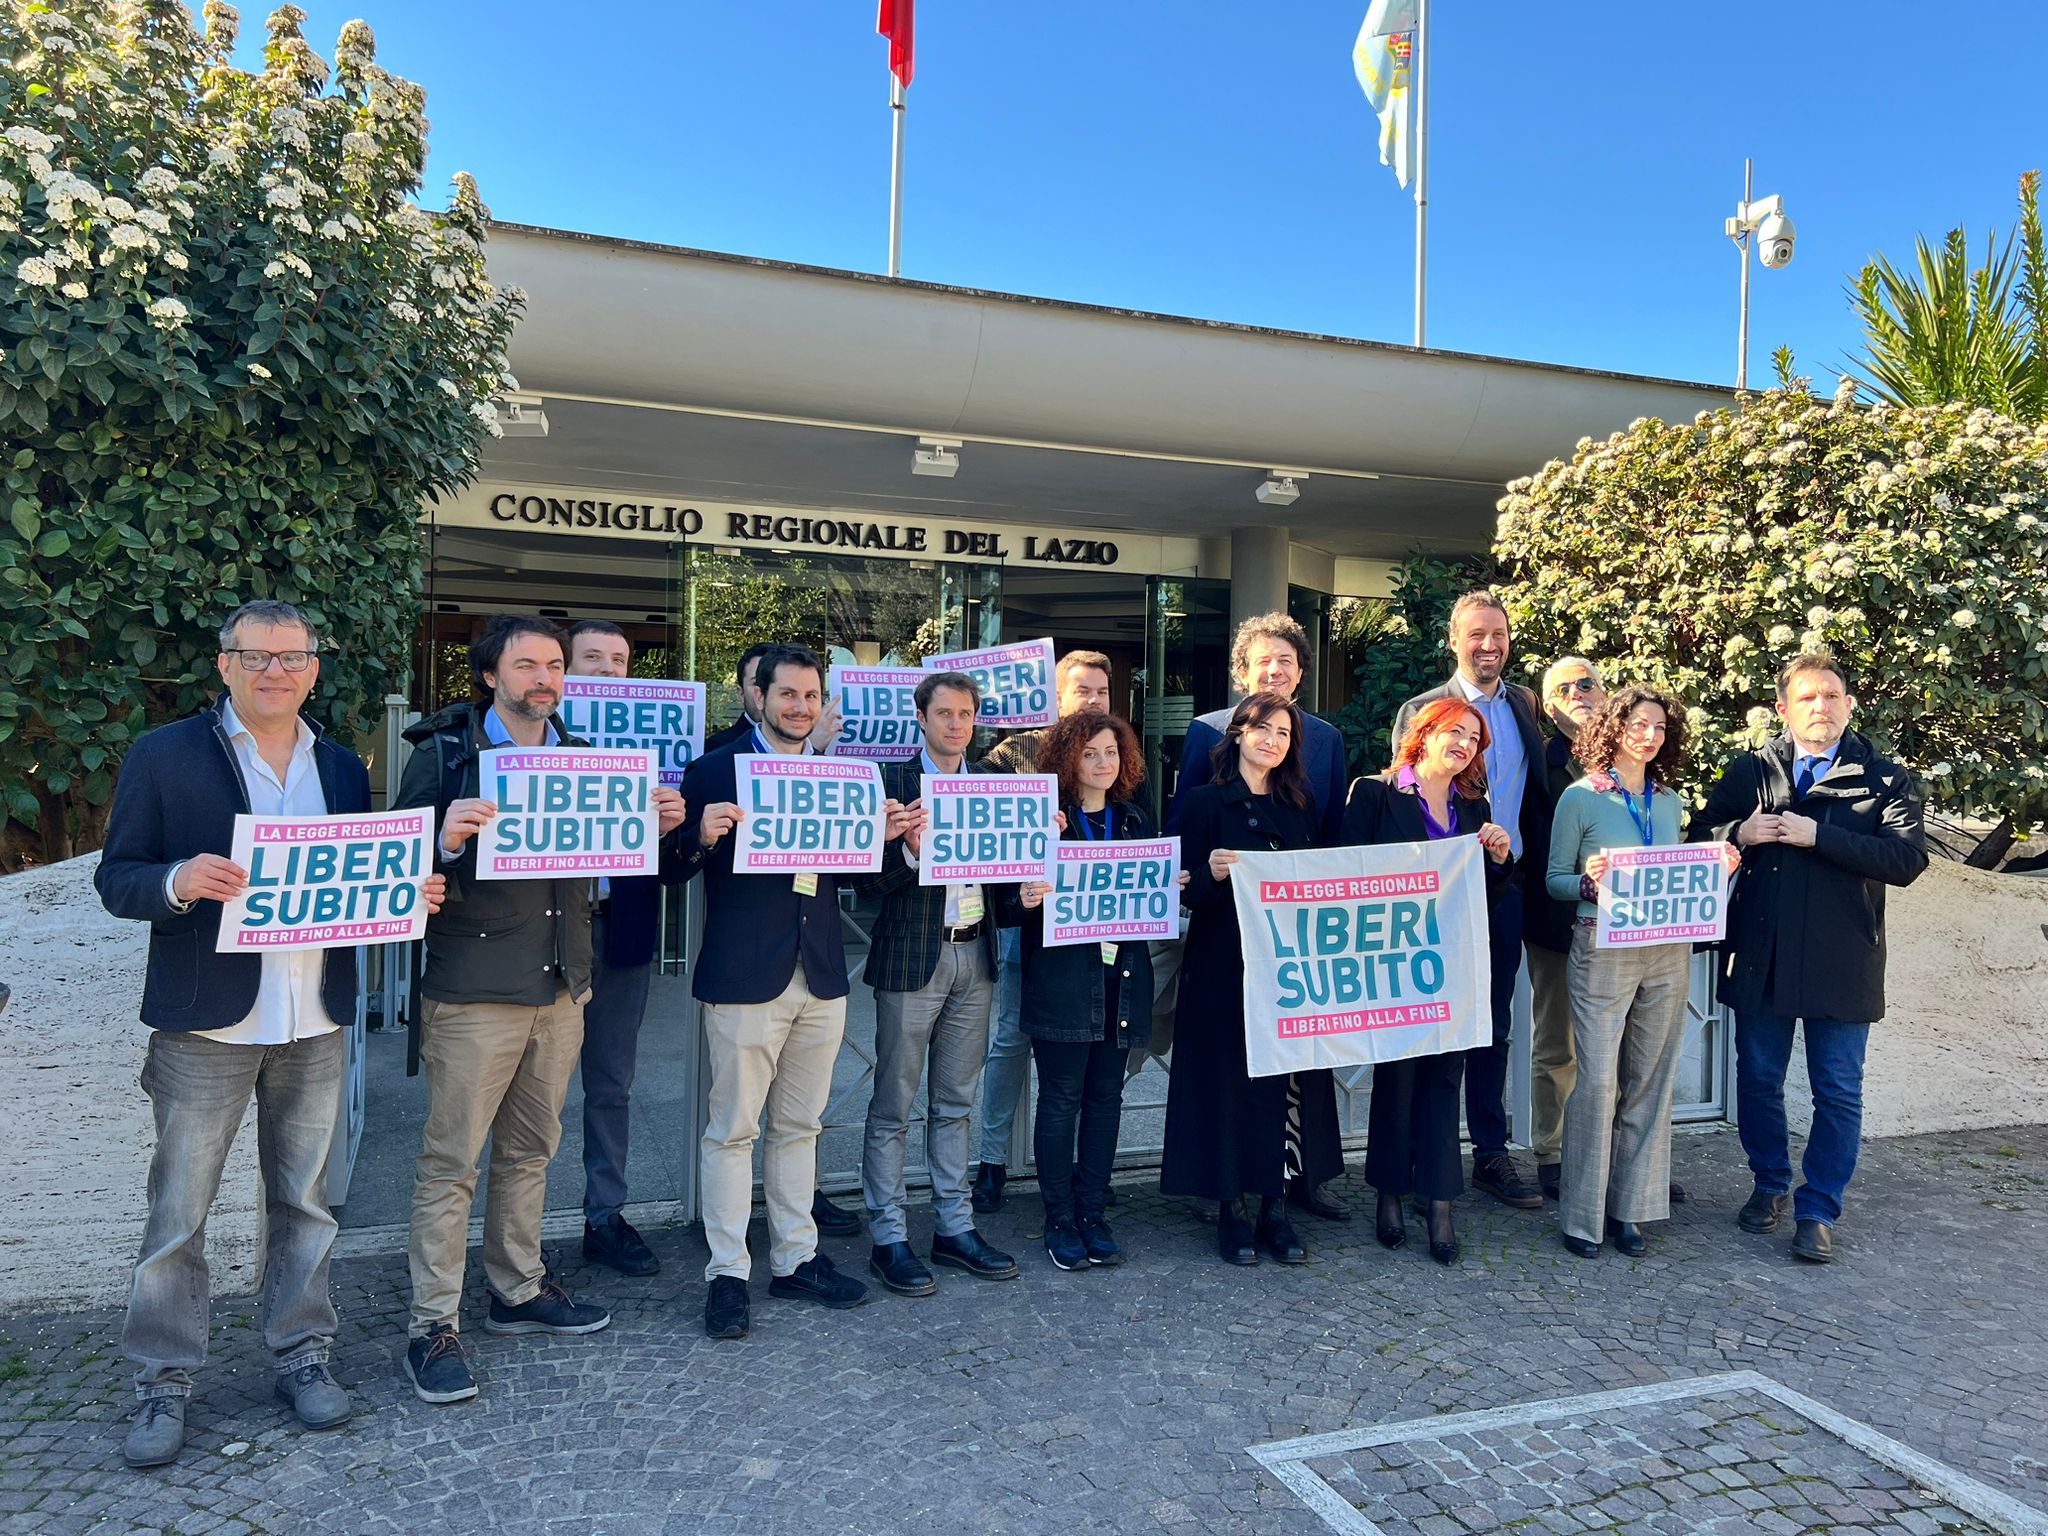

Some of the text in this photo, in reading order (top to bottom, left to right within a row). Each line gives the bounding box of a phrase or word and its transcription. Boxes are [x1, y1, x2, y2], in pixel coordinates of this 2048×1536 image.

[490, 494, 1119, 565] CONSIGLIO REGIONALE DEL LAZIO
[952, 657, 985, 669] LEGGE
[987, 648, 1042, 664] REGIONALE
[844, 673, 926, 684] LA LEGGE REGION
[969, 659, 1046, 695] BERI
[567, 685, 693, 699] LA LEGGE REGIONALE
[841, 687, 914, 717] LIBE
[981, 688, 1047, 716] BITO
[563, 700, 695, 736] LIBERI
[1024, 714, 1046, 723] FINE
[838, 719, 921, 745] SUBIT
[500, 756, 645, 770] LA LEGGE REGIONALE
[837, 747, 916, 756] LIBERI FINO ALLA
[667, 772, 684, 782] FIN
[754, 763, 872, 778] LA LEGGE REGIONALE
[496, 775, 648, 813] LIBERI
[751, 779, 877, 816] LIBERI
[935, 782, 1046, 792] LA LEGGE REGIONALE
[933, 797, 1049, 830] LIBERI
[259, 819, 420, 840] LA LEGGE REGIONALE
[494, 817, 645, 853] SUBITO
[749, 817, 874, 850] SUBITO
[751, 854, 870, 865] LIBERI FINO ALLA FINE
[932, 831, 1049, 863] SUBITO
[1061, 845, 1170, 859] LA LEGGE REGIONALE
[1616, 849, 1720, 865] LA LEGGE REGIONALE
[248, 838, 421, 887] LIBERI
[497, 855, 641, 870] LIBERI FINO ALLA FINE
[934, 867, 968, 877] LIBERI
[970, 866, 994, 876] FINO
[996, 865, 1022, 875] ALLA
[1055, 859, 1171, 893] LIBERI
[1265, 875, 1435, 899] LA LEGGE REGIONALE
[1611, 863, 1720, 898] LIBERI
[241, 882, 417, 927] SUBITO
[1054, 891, 1167, 924] SUBITO
[1609, 895, 1717, 928] SUBITO
[242, 921, 409, 944] LIBERI FINO ALLA FINE
[1057, 923, 1166, 938] LIBERI FINO ALLA FINE
[1264, 898, 1441, 958] LIBERI
[1611, 925, 1714, 941] LIBERI FINO ALLA FINE
[1276, 949, 1445, 1009] SUBITO
[1282, 1004, 1446, 1035] LIBERI FINO ALLA FINE
